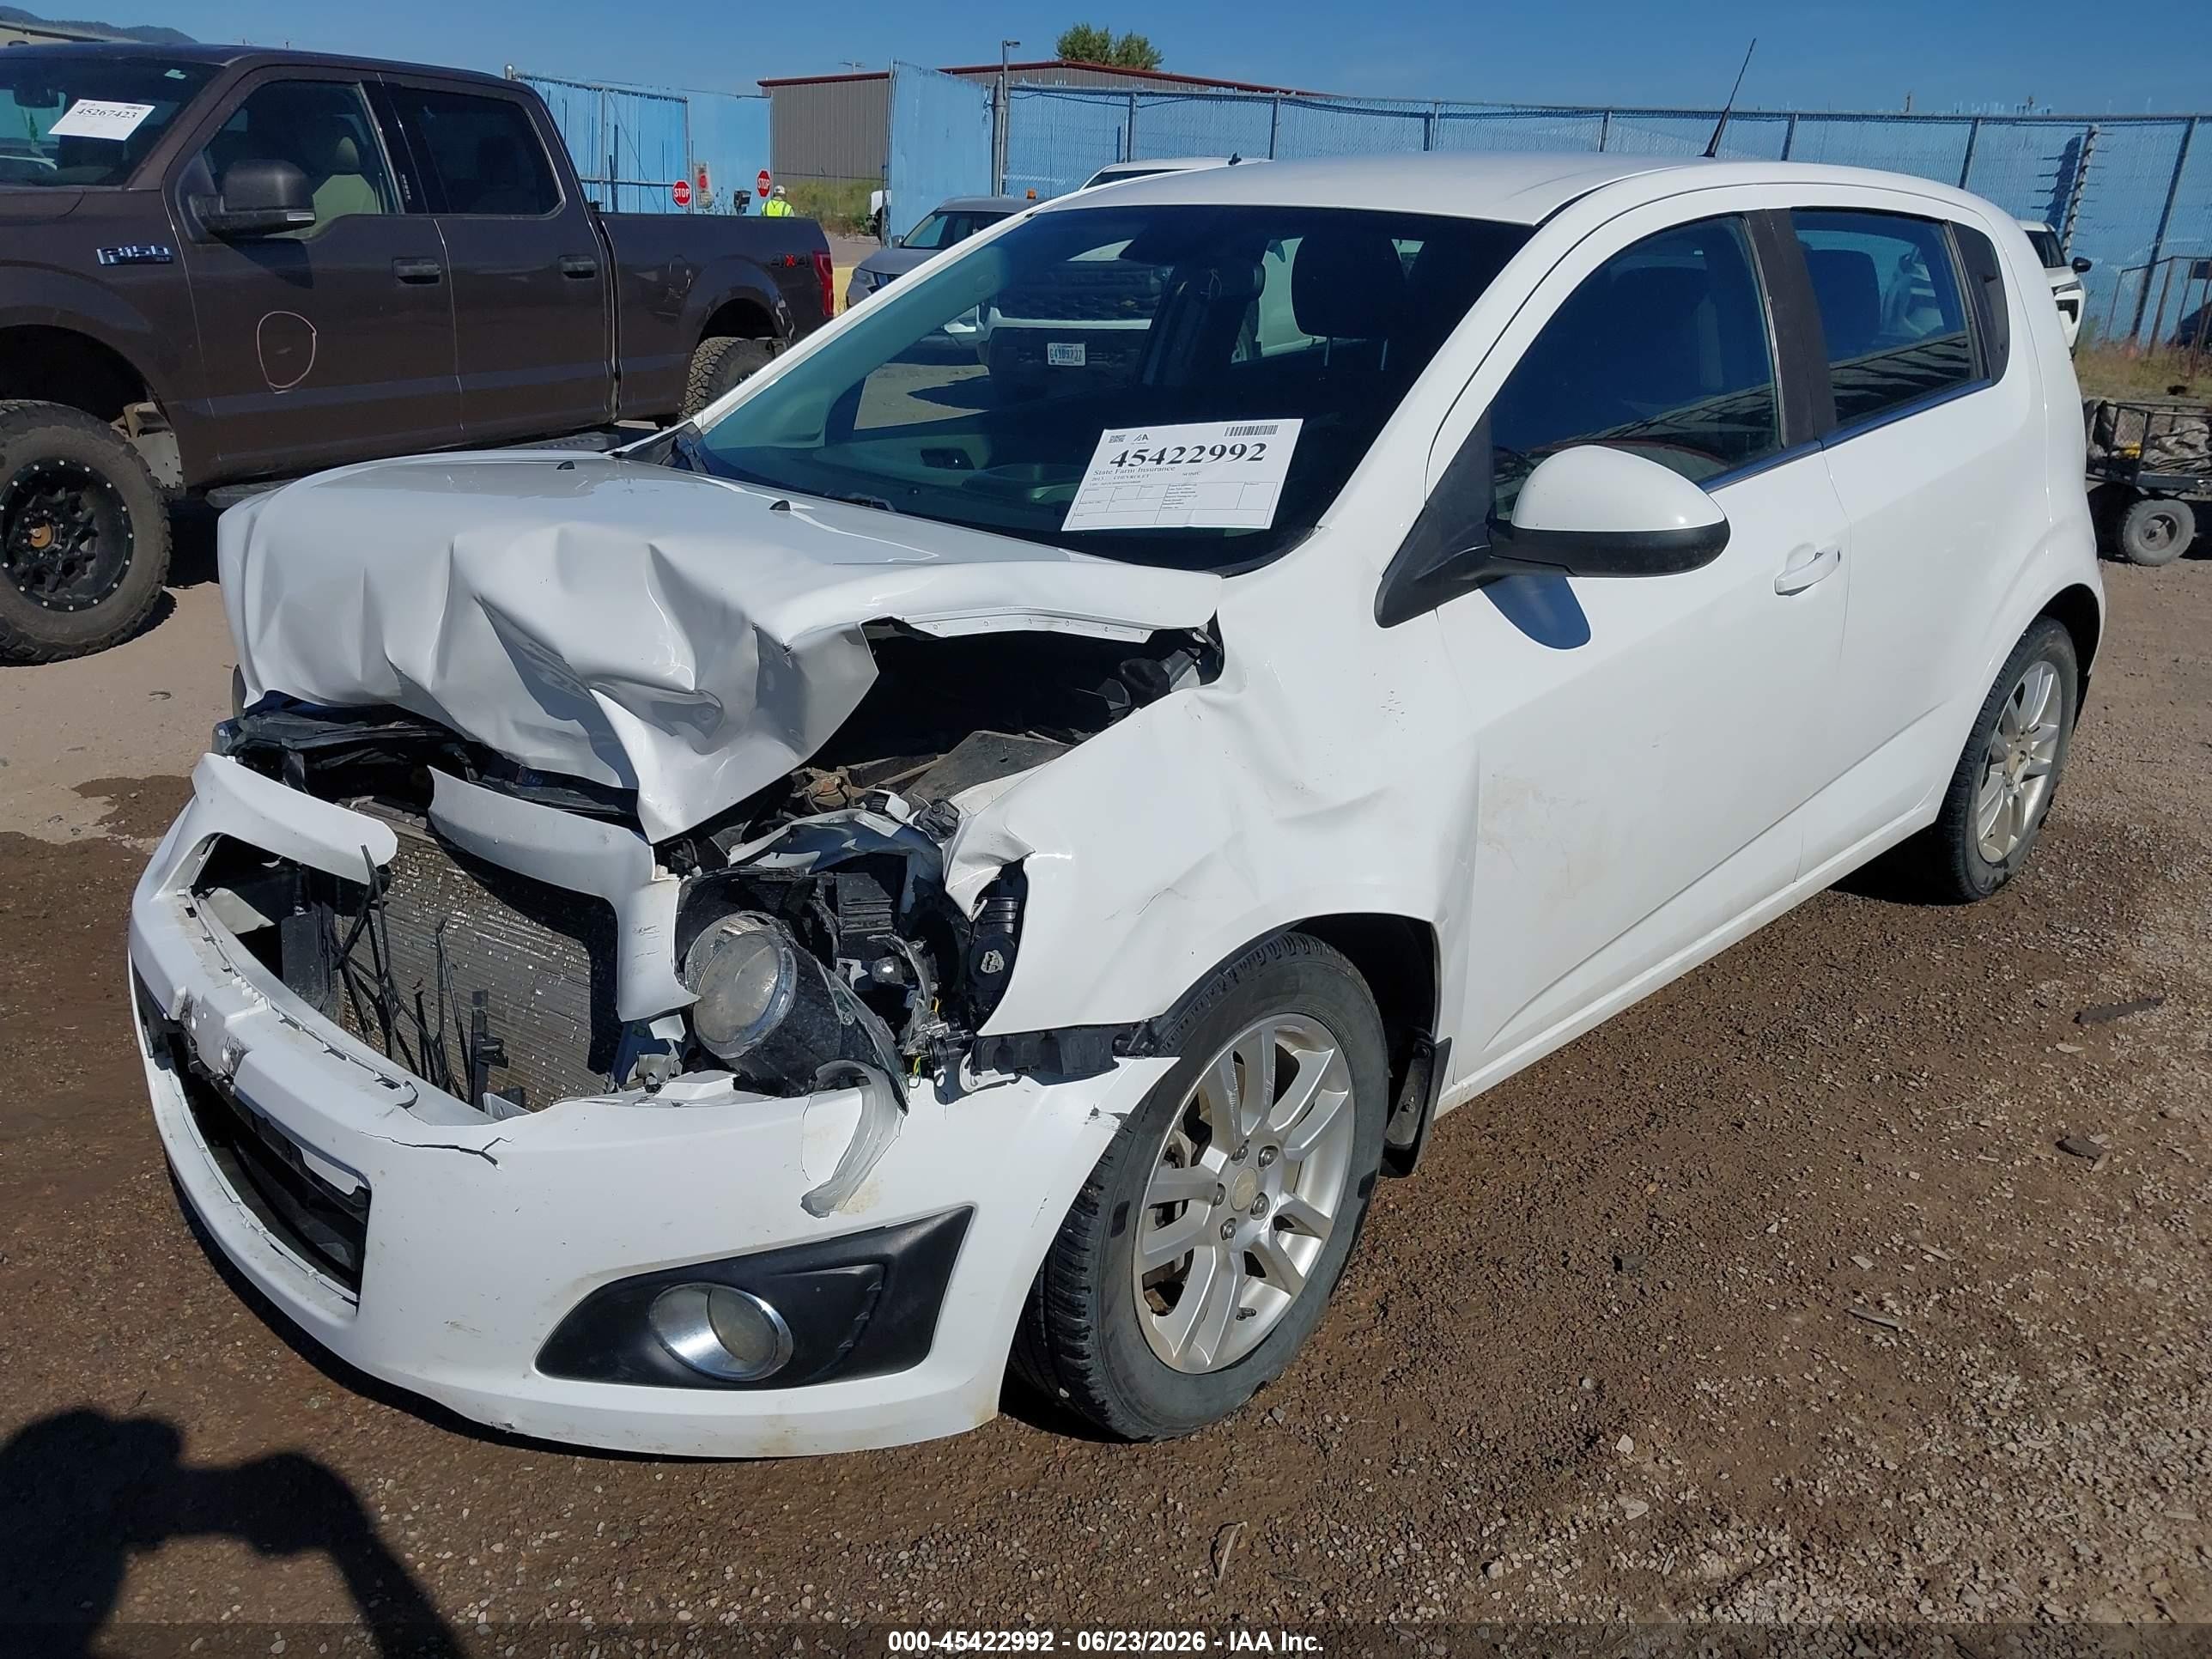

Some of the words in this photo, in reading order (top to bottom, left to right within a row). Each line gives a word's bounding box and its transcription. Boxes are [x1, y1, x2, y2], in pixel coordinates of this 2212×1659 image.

[76, 108, 138, 118] 45267423
[758, 179, 770, 190] STOP
[674, 188, 690, 198] STOP
[1109, 443, 1267, 468] 45422992
